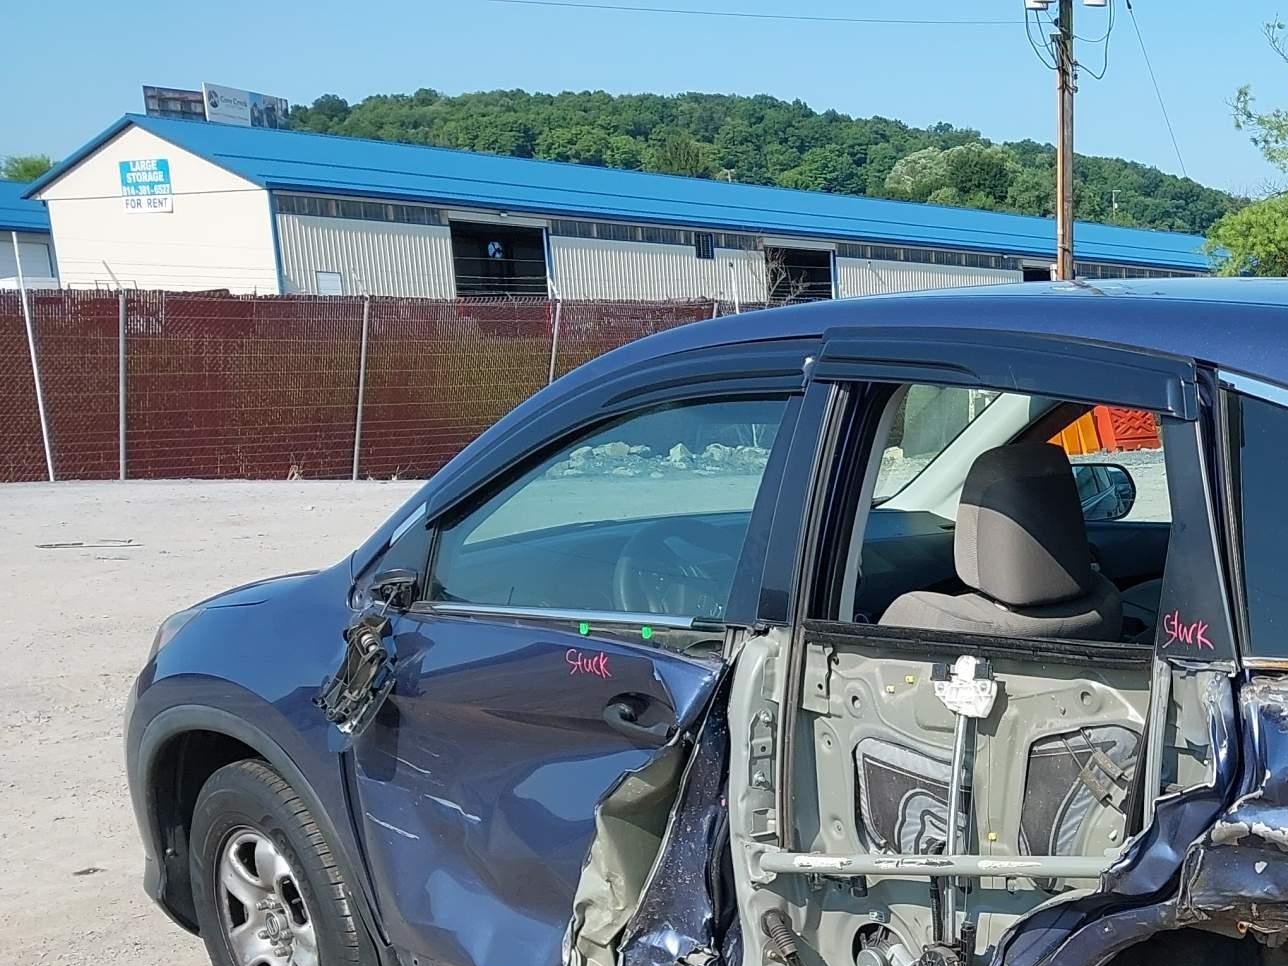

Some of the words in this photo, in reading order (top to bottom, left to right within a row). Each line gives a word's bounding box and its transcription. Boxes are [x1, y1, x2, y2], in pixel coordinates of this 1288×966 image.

[130, 160, 158, 171] LARGE
[126, 171, 165, 184] STORAGE
[125, 198, 143, 209] FOR
[146, 197, 169, 209] RENT
[565, 648, 612, 678] Stuck
